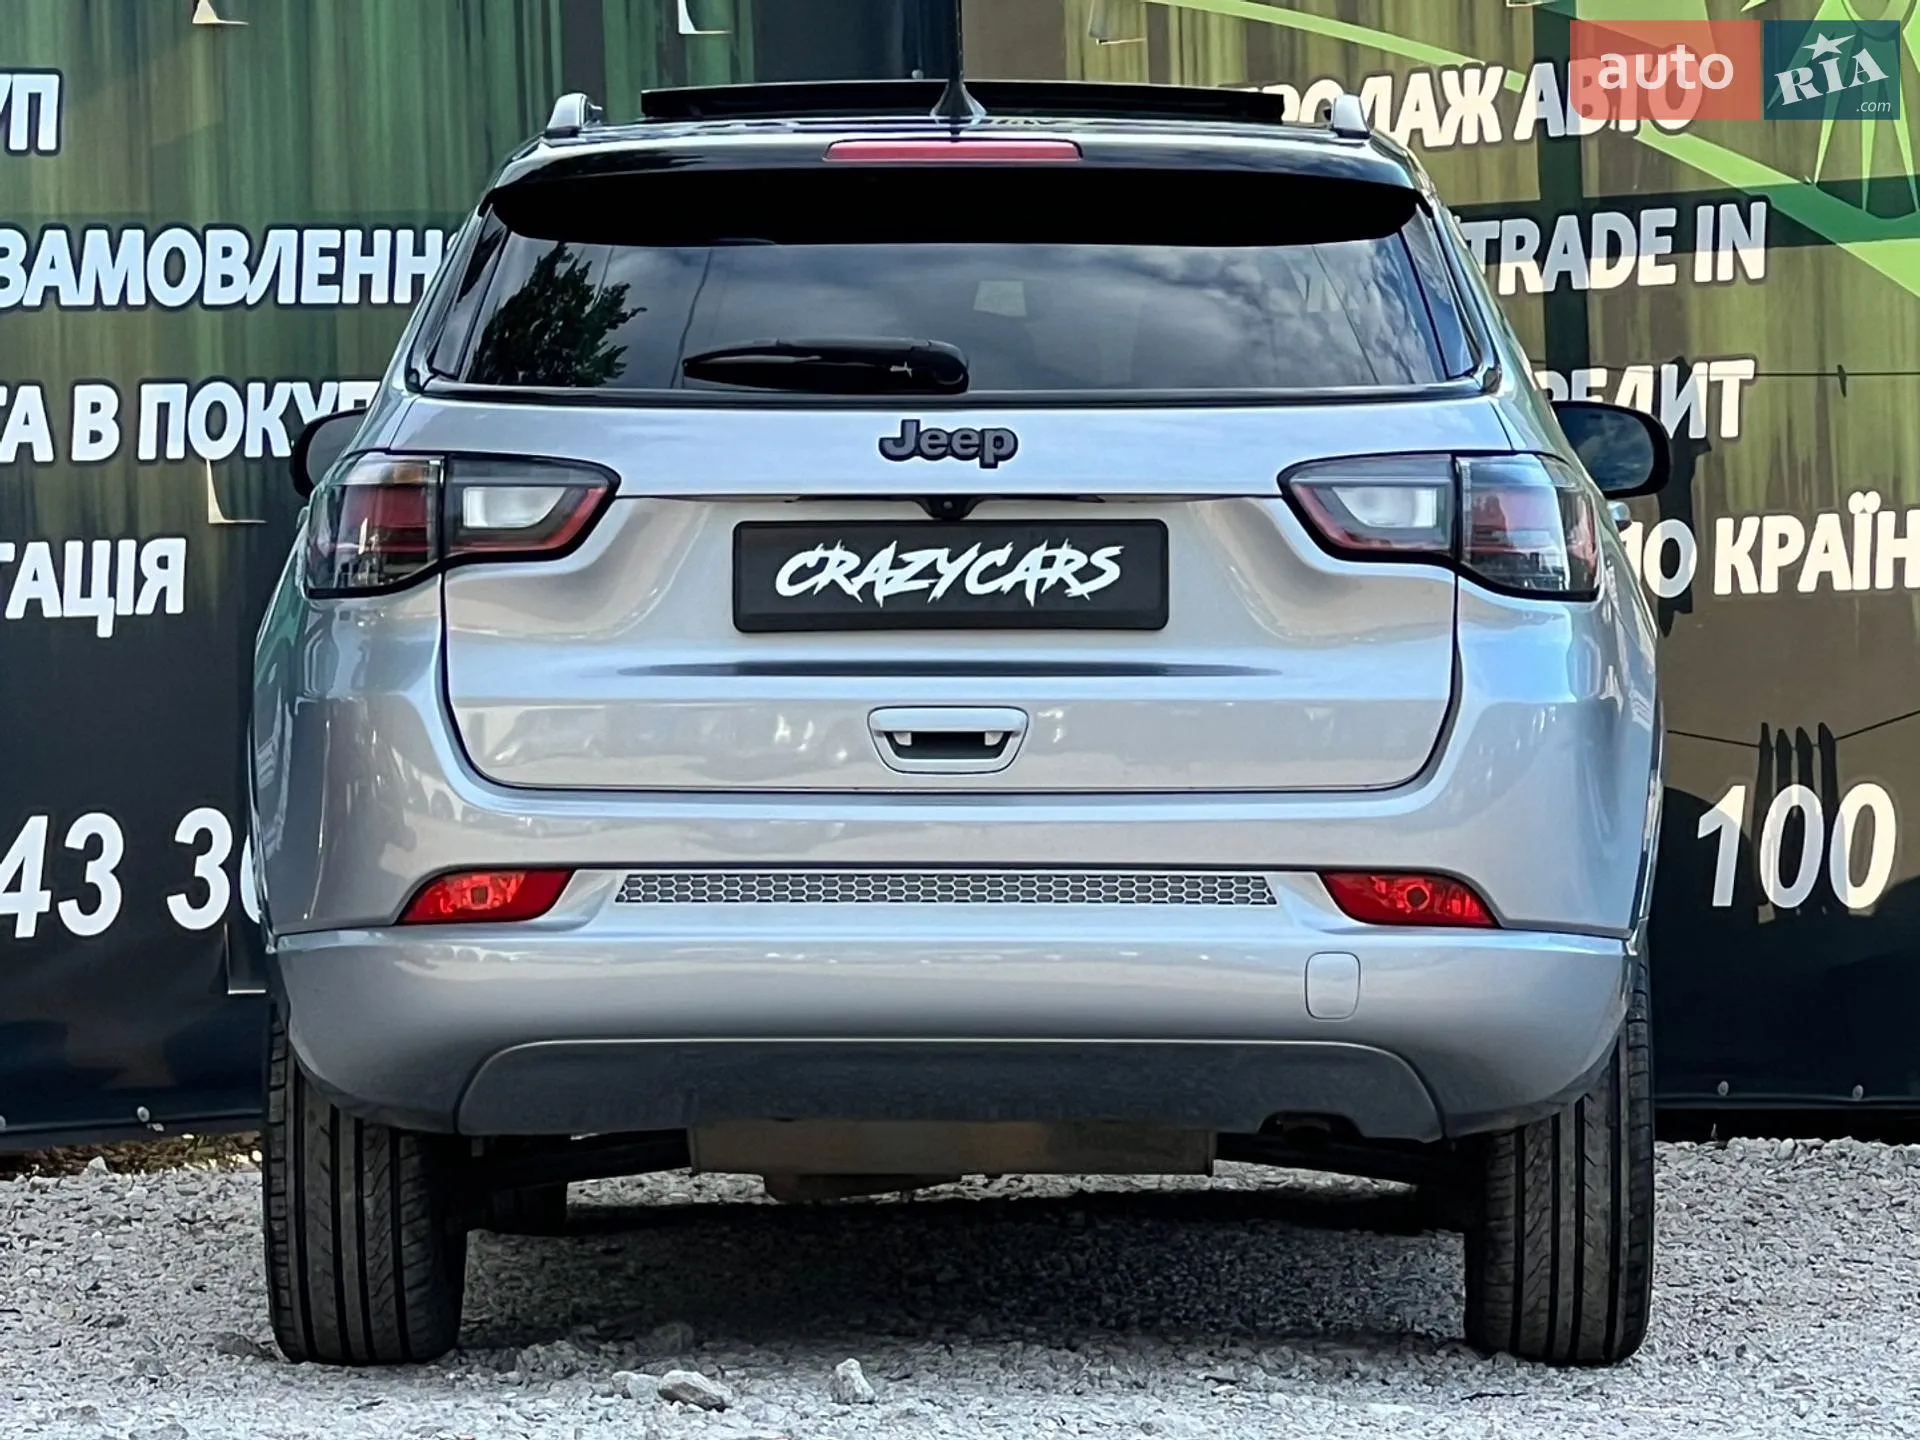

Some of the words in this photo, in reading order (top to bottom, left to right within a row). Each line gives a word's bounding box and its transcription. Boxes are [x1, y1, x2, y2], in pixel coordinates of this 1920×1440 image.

[0, 228, 458, 307] ЗАМОВЛЕНН
[1694, 201, 1767, 283] IN
[879, 419, 1018, 468] Jeep
[775, 537, 1124, 607] CRAZYCARS
[0, 811, 124, 938] 43
[1697, 782, 1897, 909] 100
